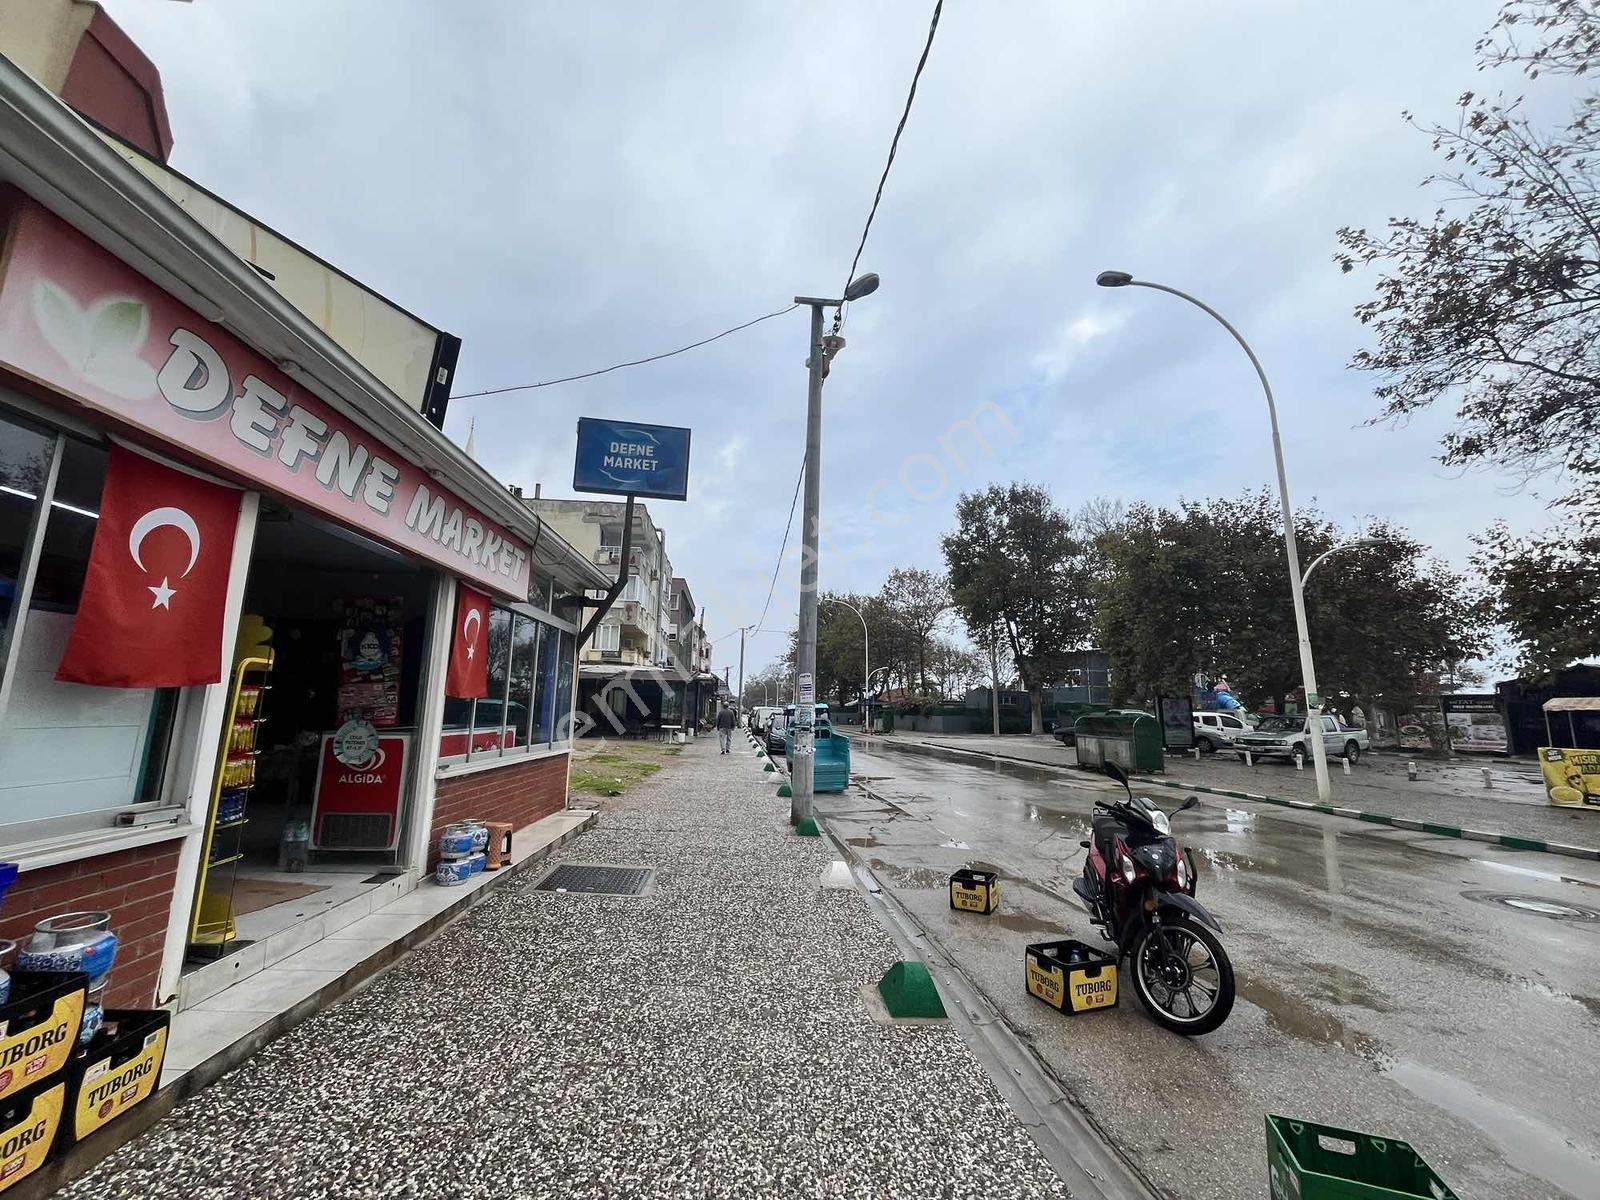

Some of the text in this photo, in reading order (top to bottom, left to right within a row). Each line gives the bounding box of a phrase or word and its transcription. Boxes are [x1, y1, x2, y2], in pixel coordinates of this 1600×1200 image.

[156, 327, 527, 583] DEFNE MARKET
[610, 442, 654, 456] DEFNE
[603, 456, 658, 471] MARKET
[956, 891, 983, 902] TUBORG
[1031, 969, 1060, 993] TUBORG
[1076, 979, 1112, 996] TUBORG
[88, 1056, 153, 1108] TUBORG
